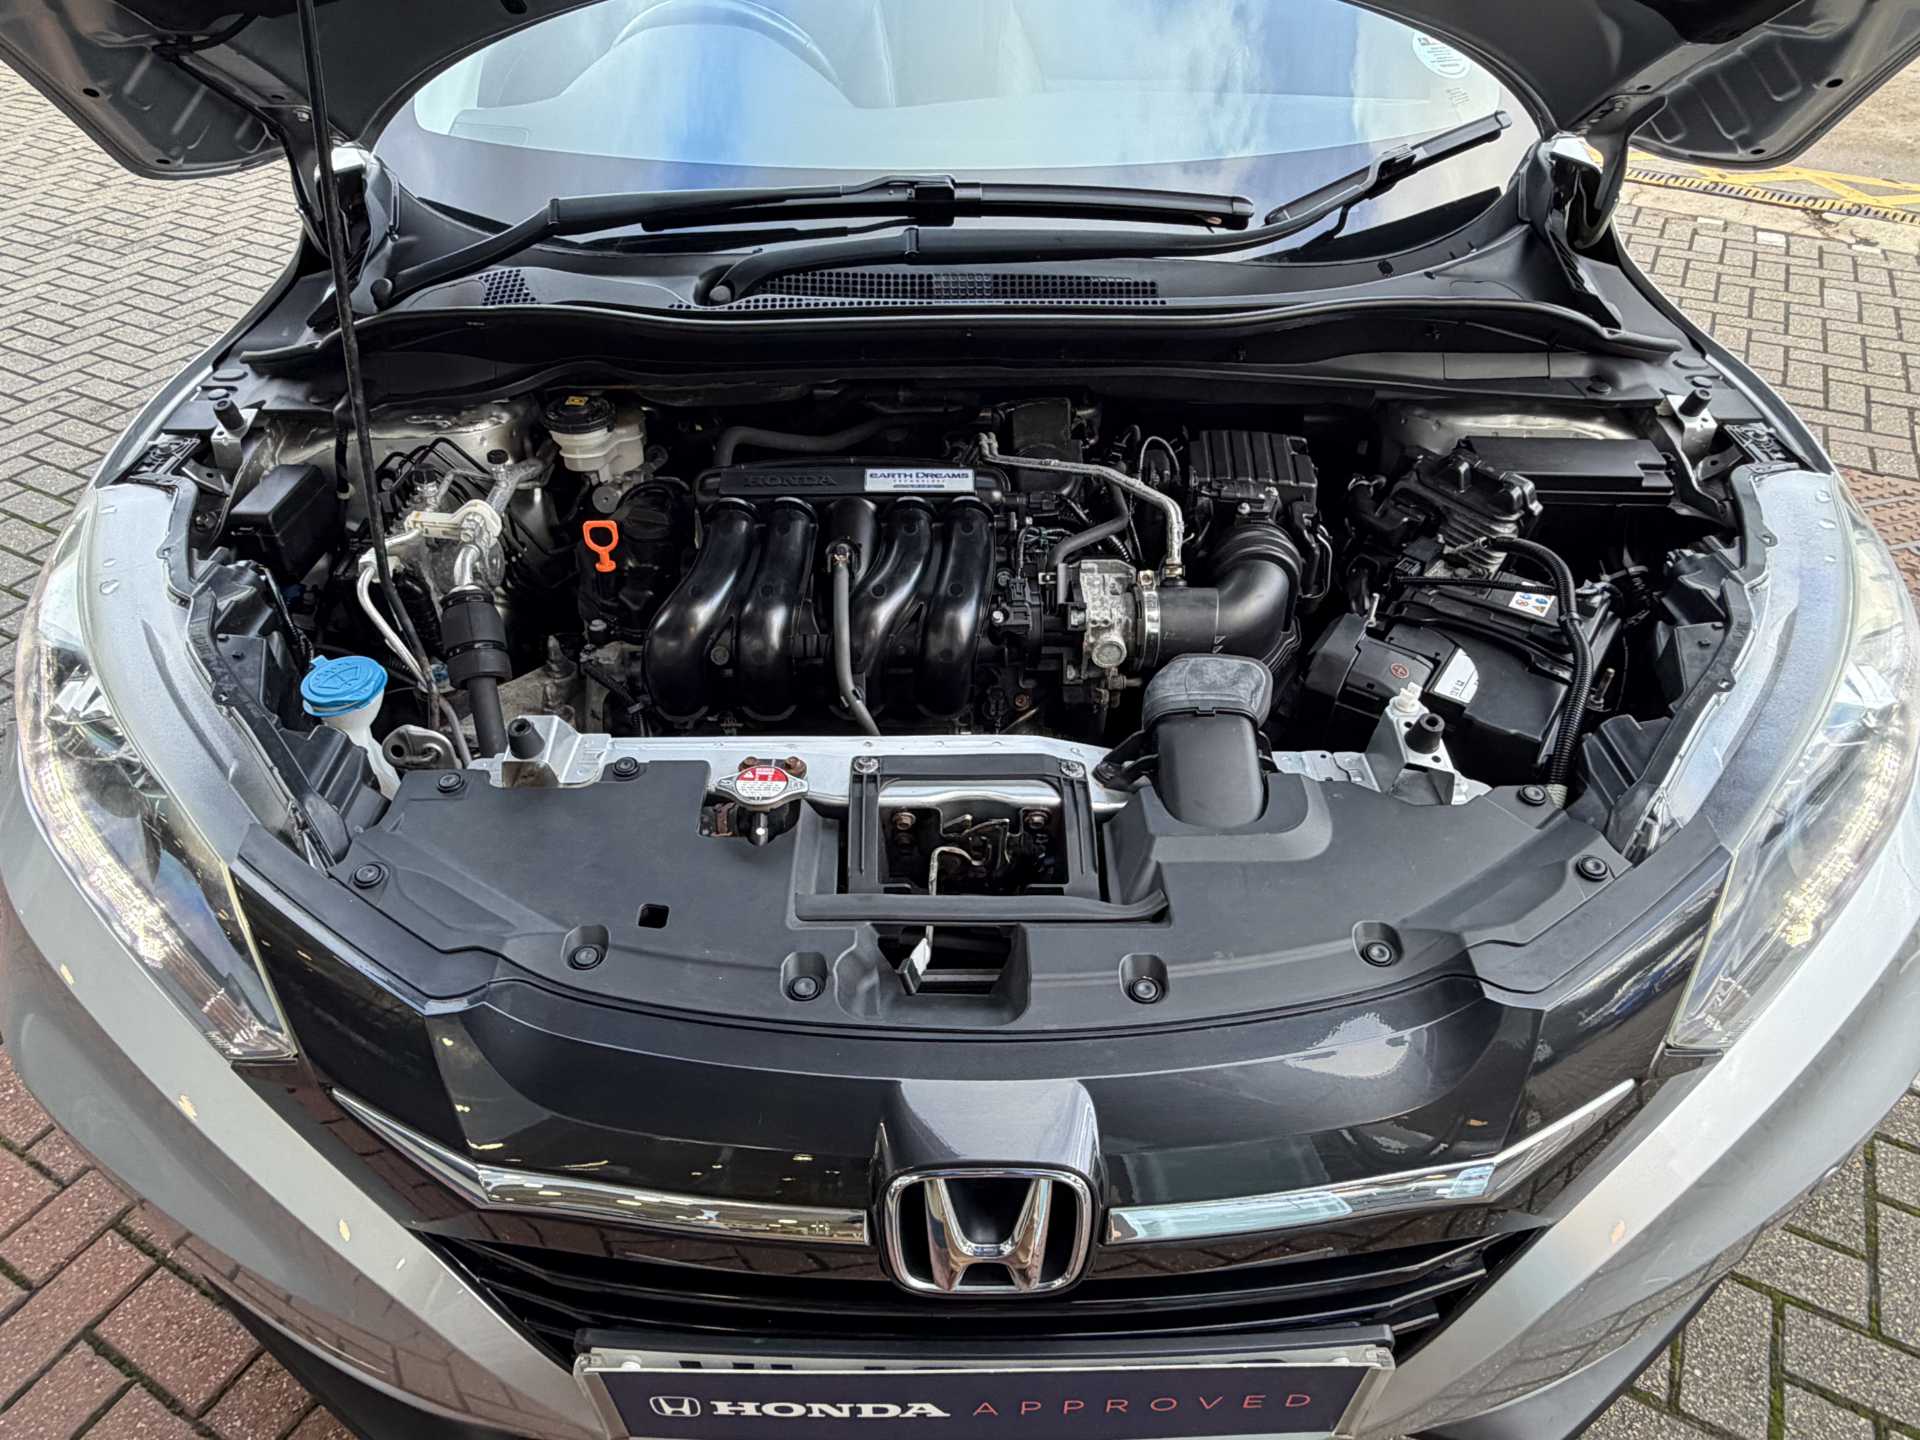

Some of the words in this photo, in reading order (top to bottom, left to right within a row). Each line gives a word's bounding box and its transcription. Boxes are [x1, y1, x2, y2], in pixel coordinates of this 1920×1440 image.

[745, 475, 838, 488] HONDA
[710, 1400, 951, 1418] HONDA
[972, 1393, 1311, 1417] APPROVED
